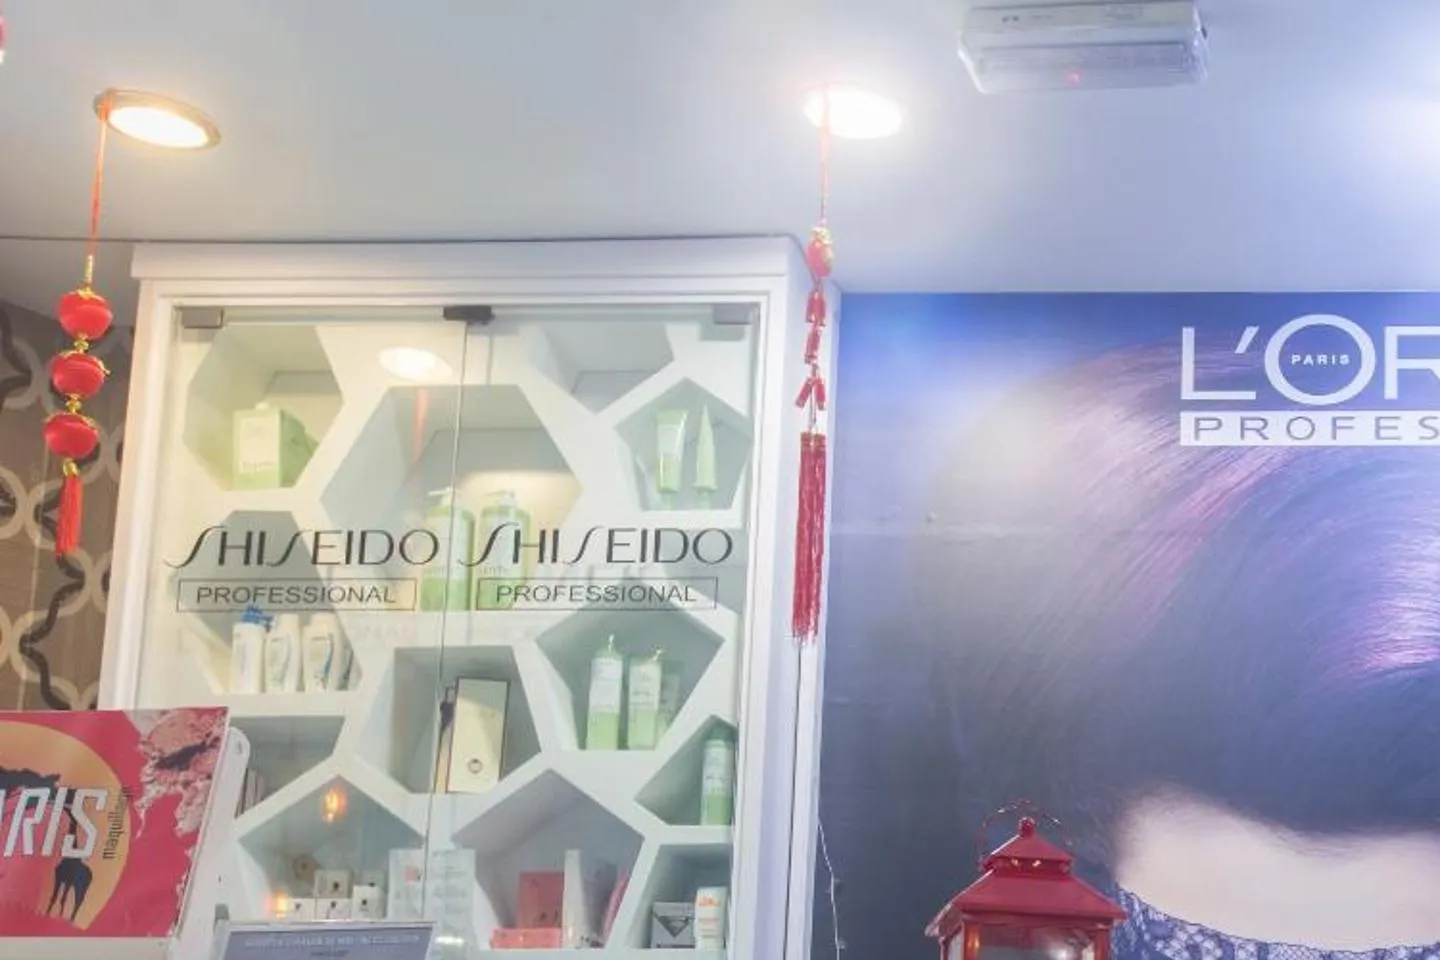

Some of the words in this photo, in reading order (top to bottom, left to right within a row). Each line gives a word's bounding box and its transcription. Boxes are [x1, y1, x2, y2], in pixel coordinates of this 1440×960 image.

[1290, 353, 1351, 366] PARIS
[163, 525, 440, 569] SHISEIDO
[458, 522, 733, 567] SHISEIDO
[196, 586, 397, 605] PROFESSIONAL
[495, 584, 697, 604] PROFESSIONAL
[0, 788, 109, 859] RIS
